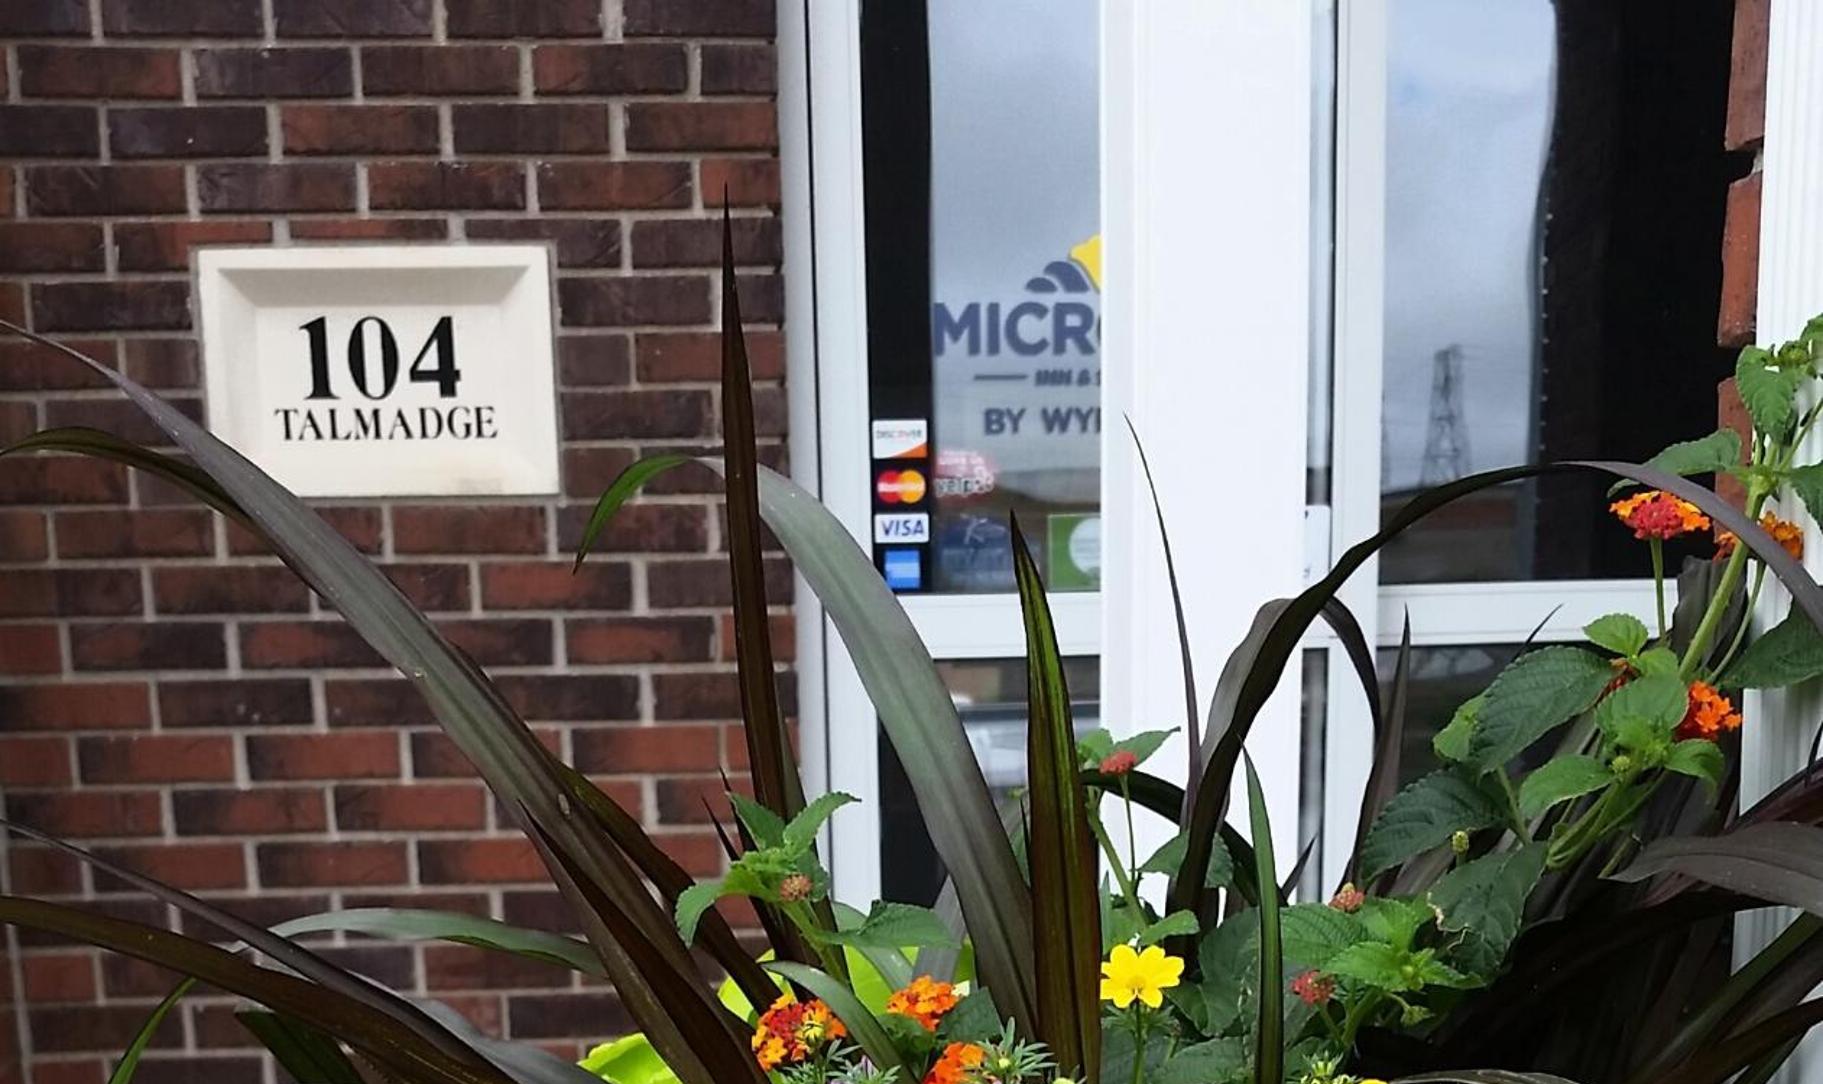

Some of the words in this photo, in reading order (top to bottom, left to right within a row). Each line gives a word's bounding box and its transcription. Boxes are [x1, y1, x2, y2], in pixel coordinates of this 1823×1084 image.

[932, 301, 1101, 357] MICR
[299, 315, 461, 401] 104
[274, 405, 498, 441] TALMADGE
[984, 406, 1027, 435] BY
[1041, 406, 1101, 435] WY
[880, 519, 925, 537] VISA
